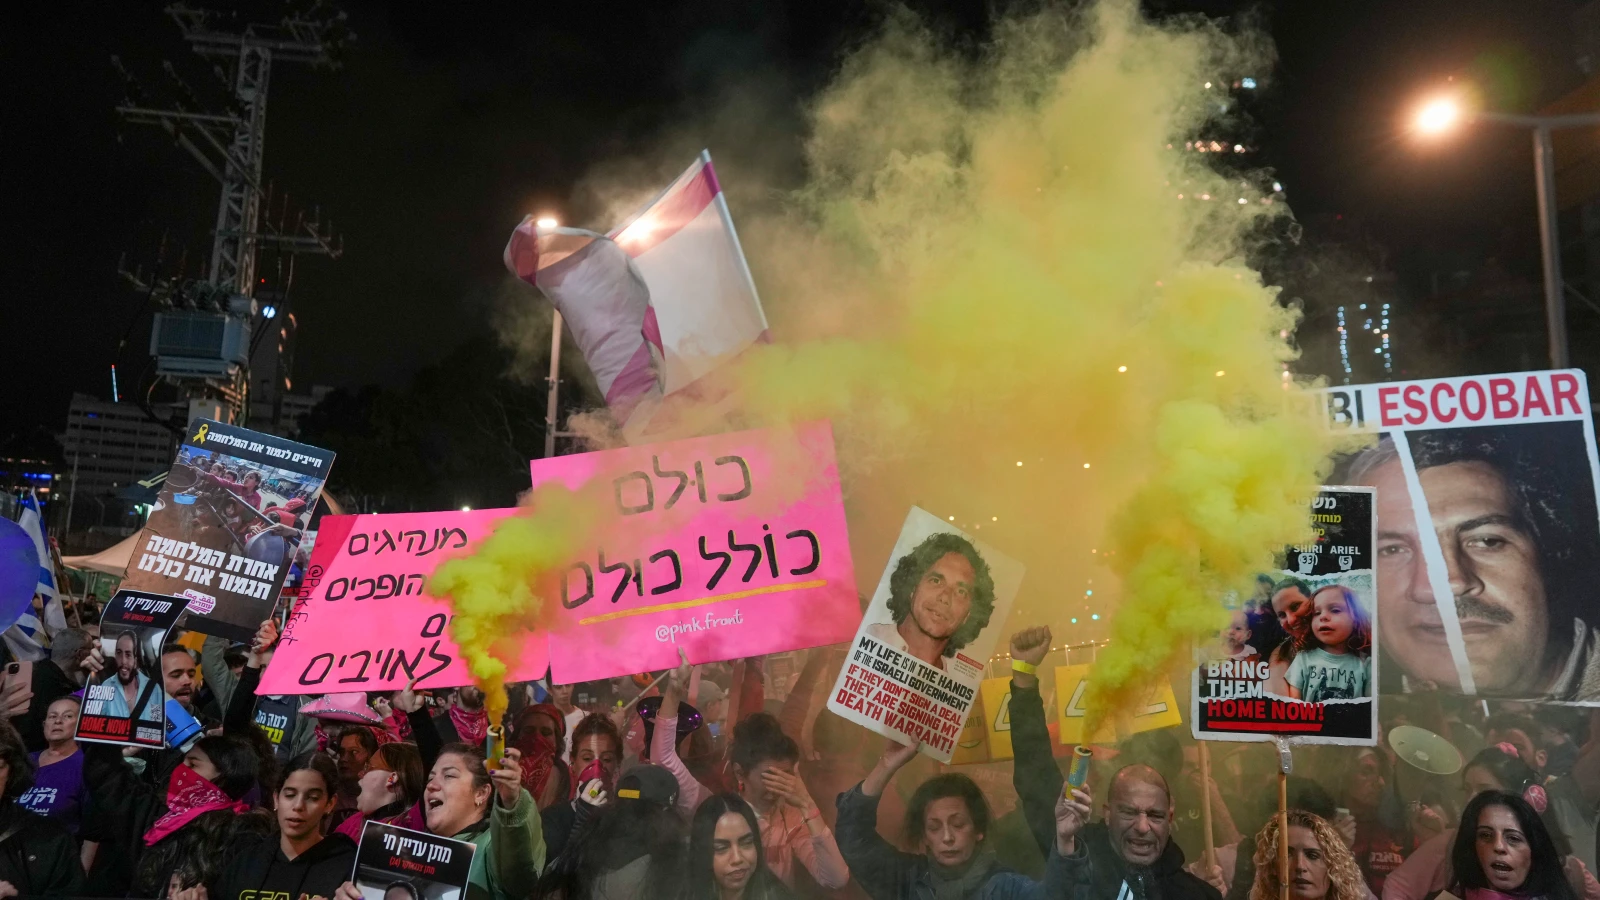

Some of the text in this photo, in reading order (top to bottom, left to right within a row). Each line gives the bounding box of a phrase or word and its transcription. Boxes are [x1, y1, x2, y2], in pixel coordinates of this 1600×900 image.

[1327, 373, 1583, 429] BI ESCOBAR
[207, 431, 323, 468] חייבים לגמור את המלחמה
[1308, 514, 1342, 525] מוחזק
[348, 527, 468, 556] מנהיגים
[1293, 544, 1323, 554] SHIRI
[1330, 546, 1361, 555] ARIEL
[137, 553, 185, 578] כולנו
[146, 535, 280, 581] אחרת המלחמה
[184, 565, 216, 586] את
[218, 572, 272, 600] תגמור
[124, 596, 135, 608] חי
[130, 597, 154, 611] עדיין
[150, 600, 172, 614] מתן
[655, 609, 743, 643] @pink.front
[859, 636, 878, 653] MY
[877, 644, 903, 665] LIFE
[900, 656, 910, 669] IS
[909, 660, 917, 673] IN
[917, 664, 939, 684] THE
[937, 674, 974, 701] HANDS
[1207, 660, 1270, 680] BRING
[1309, 665, 1366, 685] BATMA
[88, 685, 115, 700] BRING
[853, 650, 969, 713] OF THE ISRAELI GOVERNMENT
[1207, 680, 1264, 698] THEM
[847, 663, 860, 675] IF
[859, 668, 884, 688] THEY
[883, 680, 911, 700] DON'T
[908, 692, 931, 711] SIGN
[930, 703, 938, 714] A
[938, 706, 962, 726] DEAL
[84, 700, 104, 715] HIM
[843, 675, 875, 699] THEY
[874, 690, 899, 710] ARE
[897, 701, 941, 730] SIGNING
[941, 722, 960, 739] MY
[1207, 699, 1325, 722] HOME NOW!
[80, 716, 106, 732] HOME
[106, 718, 132, 735] NOW!
[835, 688, 955, 754] DEATH WARRANT!
[383, 833, 452, 863] מתן עדיין חי
